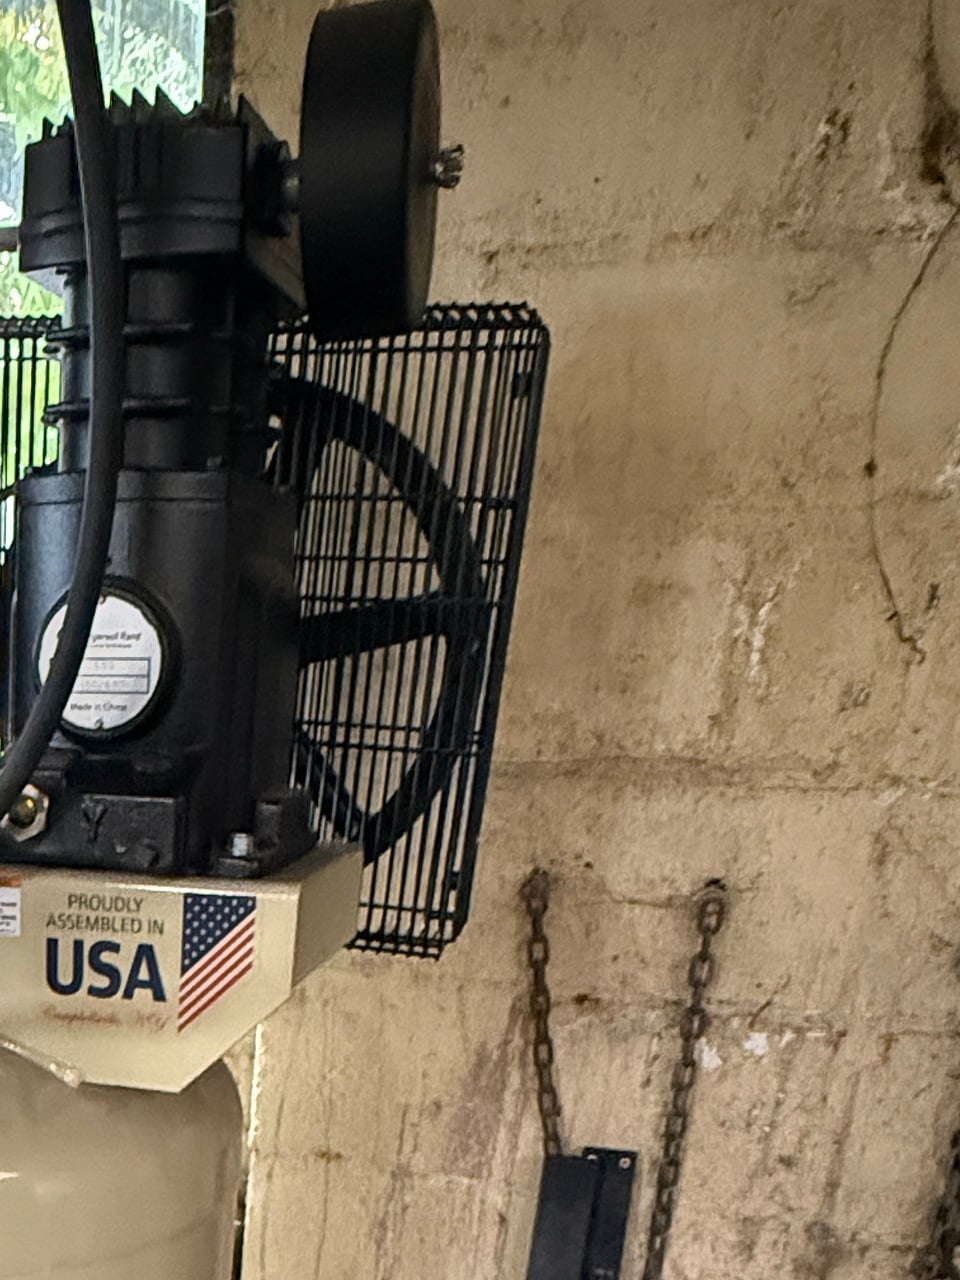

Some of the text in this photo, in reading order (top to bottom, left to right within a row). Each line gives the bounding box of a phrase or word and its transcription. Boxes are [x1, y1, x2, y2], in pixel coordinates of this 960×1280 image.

[67, 893, 143, 912] PROUDLY
[46, 912, 164, 934] ASSEMBLED IN
[46, 937, 167, 1002] USA
